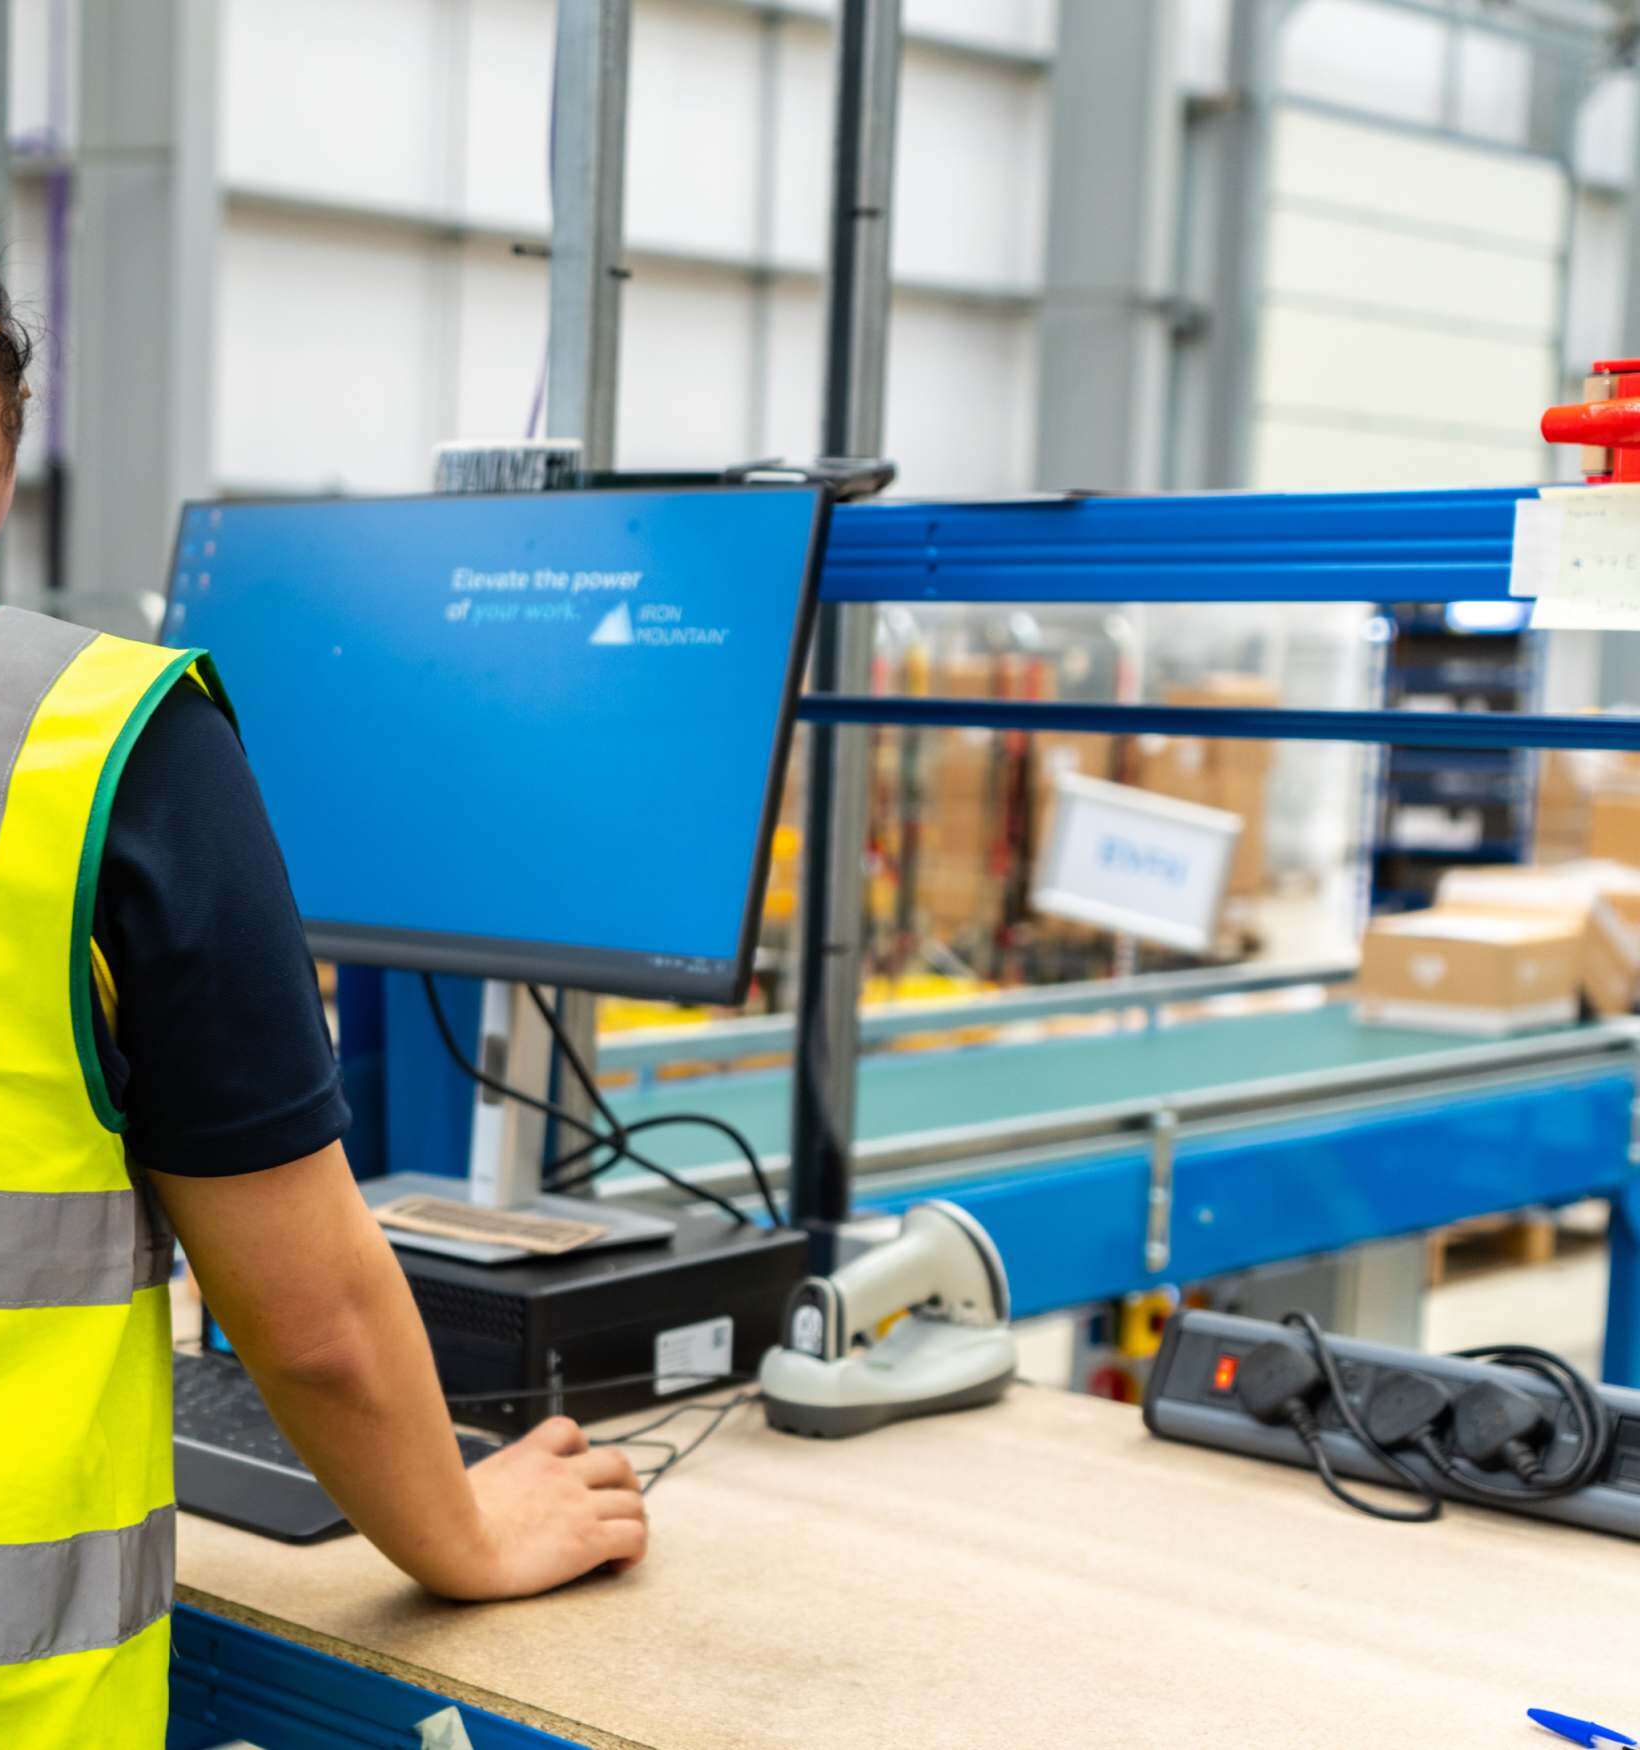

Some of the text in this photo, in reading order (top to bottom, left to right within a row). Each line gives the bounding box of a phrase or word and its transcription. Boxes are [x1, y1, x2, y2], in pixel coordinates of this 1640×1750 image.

[451, 567, 643, 593] Elevate the power
[444, 598, 472, 621] of
[472, 602, 520, 626] your
[638, 604, 683, 622] IRON
